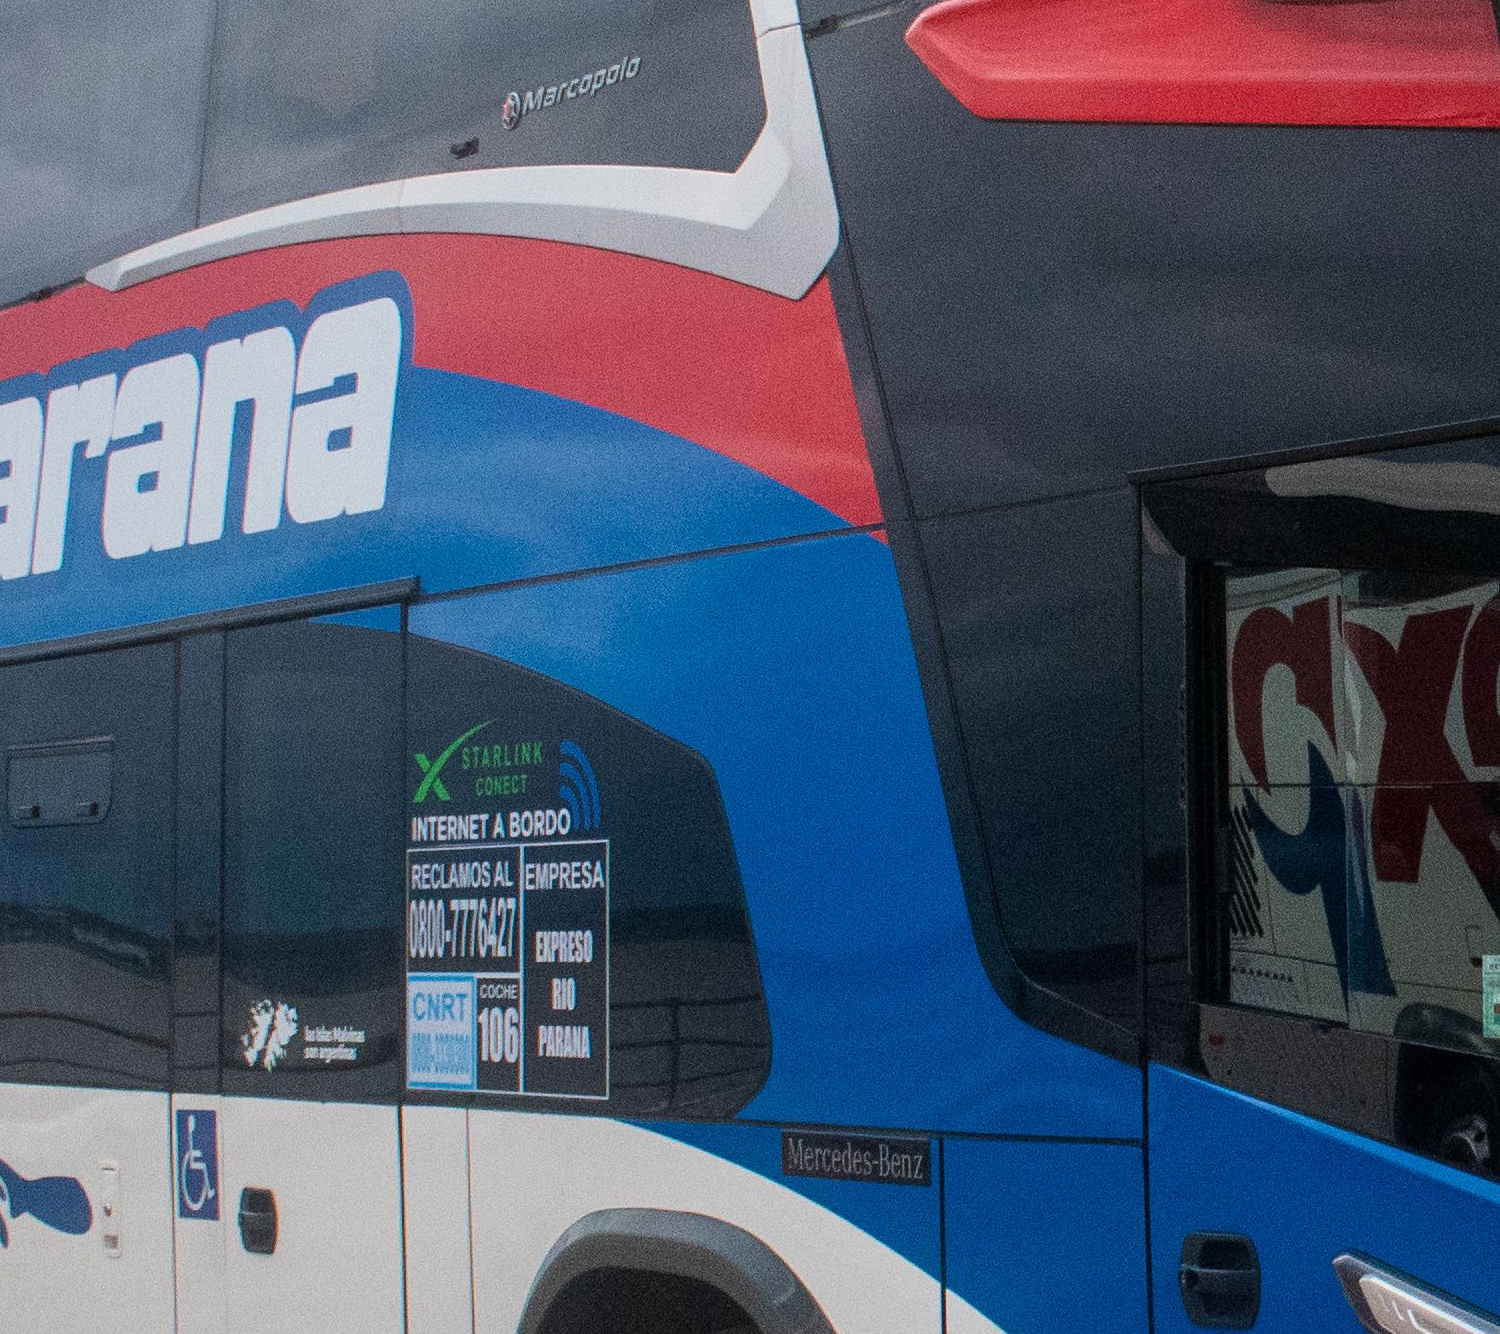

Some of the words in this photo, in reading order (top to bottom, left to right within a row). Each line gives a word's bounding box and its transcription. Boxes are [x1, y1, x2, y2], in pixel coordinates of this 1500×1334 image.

[521, 56, 642, 116] Marcopolo
[461, 741, 544, 770] STARLINK
[475, 774, 528, 797] CONECT
[411, 814, 491, 842] INTERNET
[492, 813, 507, 838] A
[509, 808, 572, 838] BORDO
[411, 862, 491, 890] RECLAMOS
[493, 861, 515, 887] AL
[525, 859, 606, 891] EMPRESA
[408, 897, 518, 959] 0800-7776427
[535, 929, 594, 964] EXPRESO
[412, 990, 468, 1023] CNRT
[479, 982, 519, 1000] COCHE
[551, 976, 577, 1011] RIO
[478, 1005, 520, 1064] 106
[536, 1024, 592, 1060] PARANA
[787, 1137, 924, 1180] Mercedes-Benz
